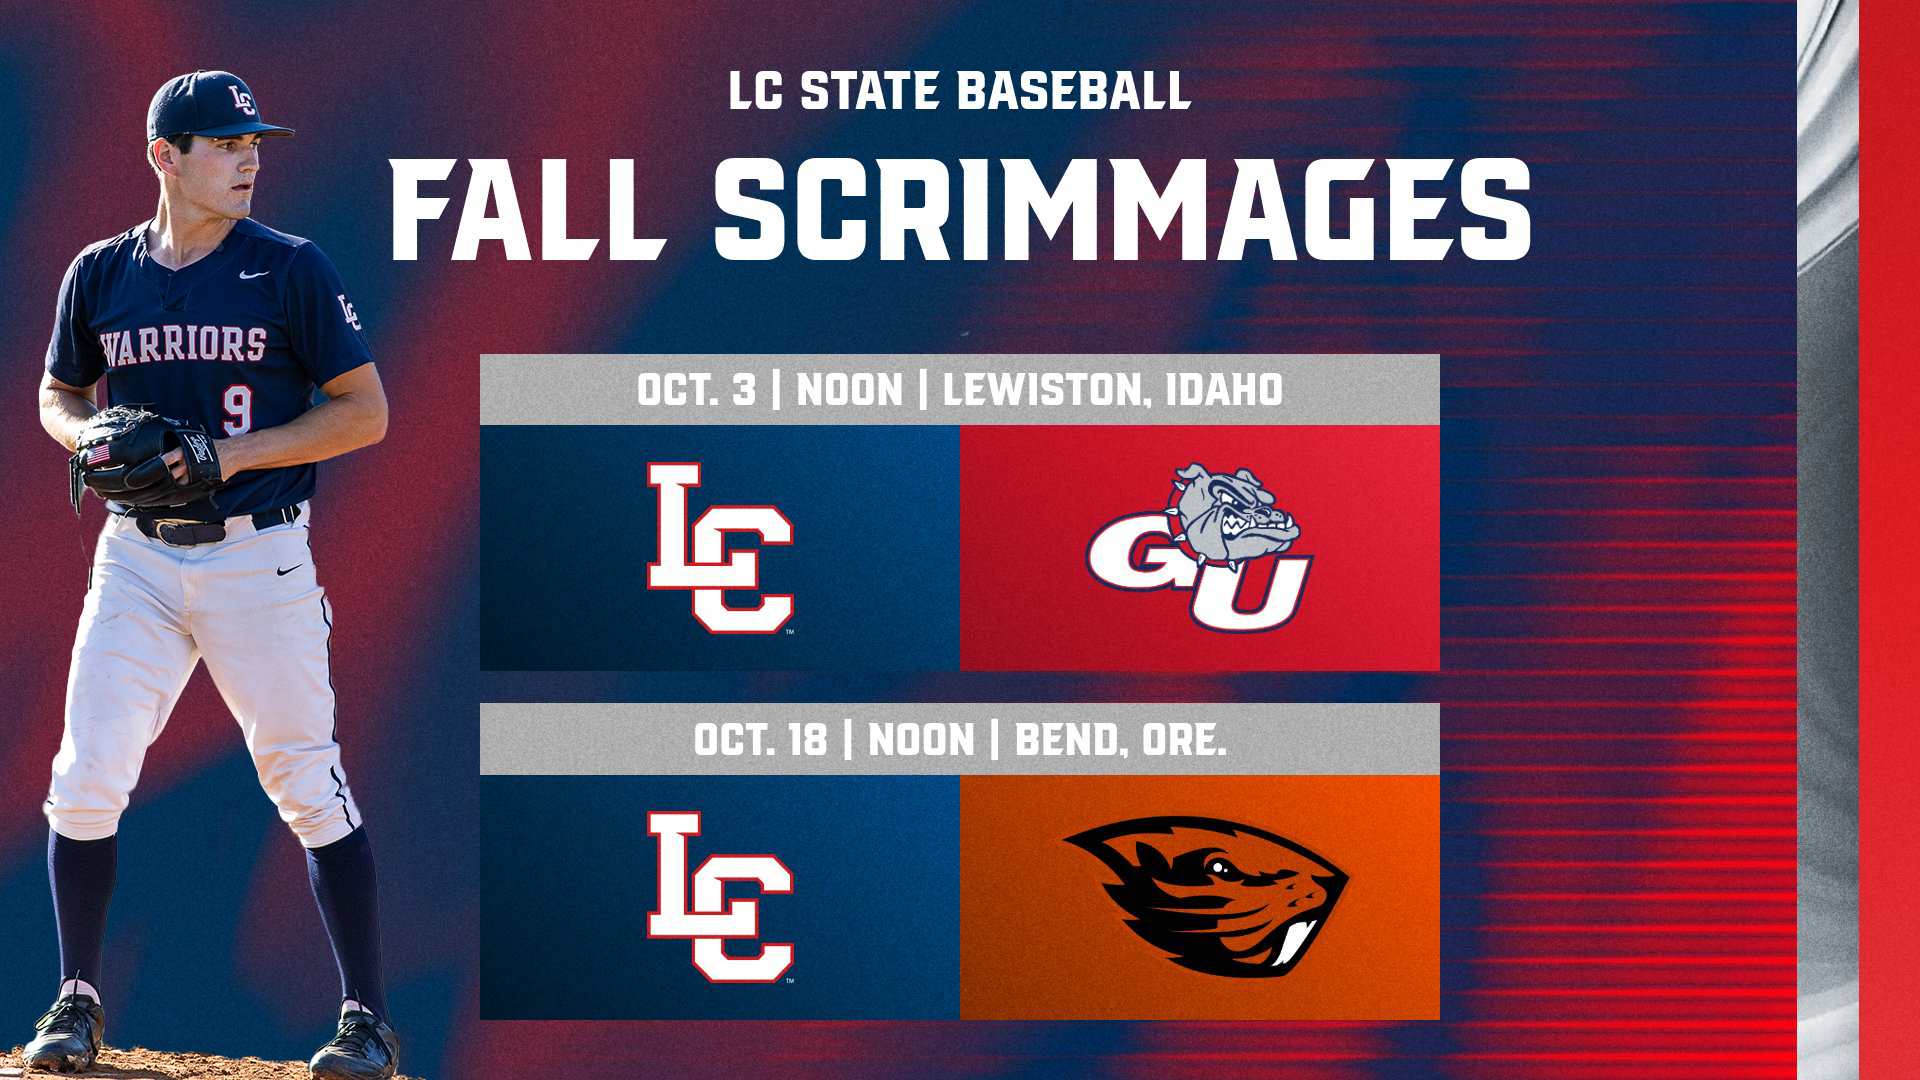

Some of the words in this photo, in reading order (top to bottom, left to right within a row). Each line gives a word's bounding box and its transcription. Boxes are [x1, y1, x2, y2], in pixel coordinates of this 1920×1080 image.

[227, 84, 256, 116] LC
[99, 324, 267, 367] WARRIORS
[222, 384, 253, 438] 9
